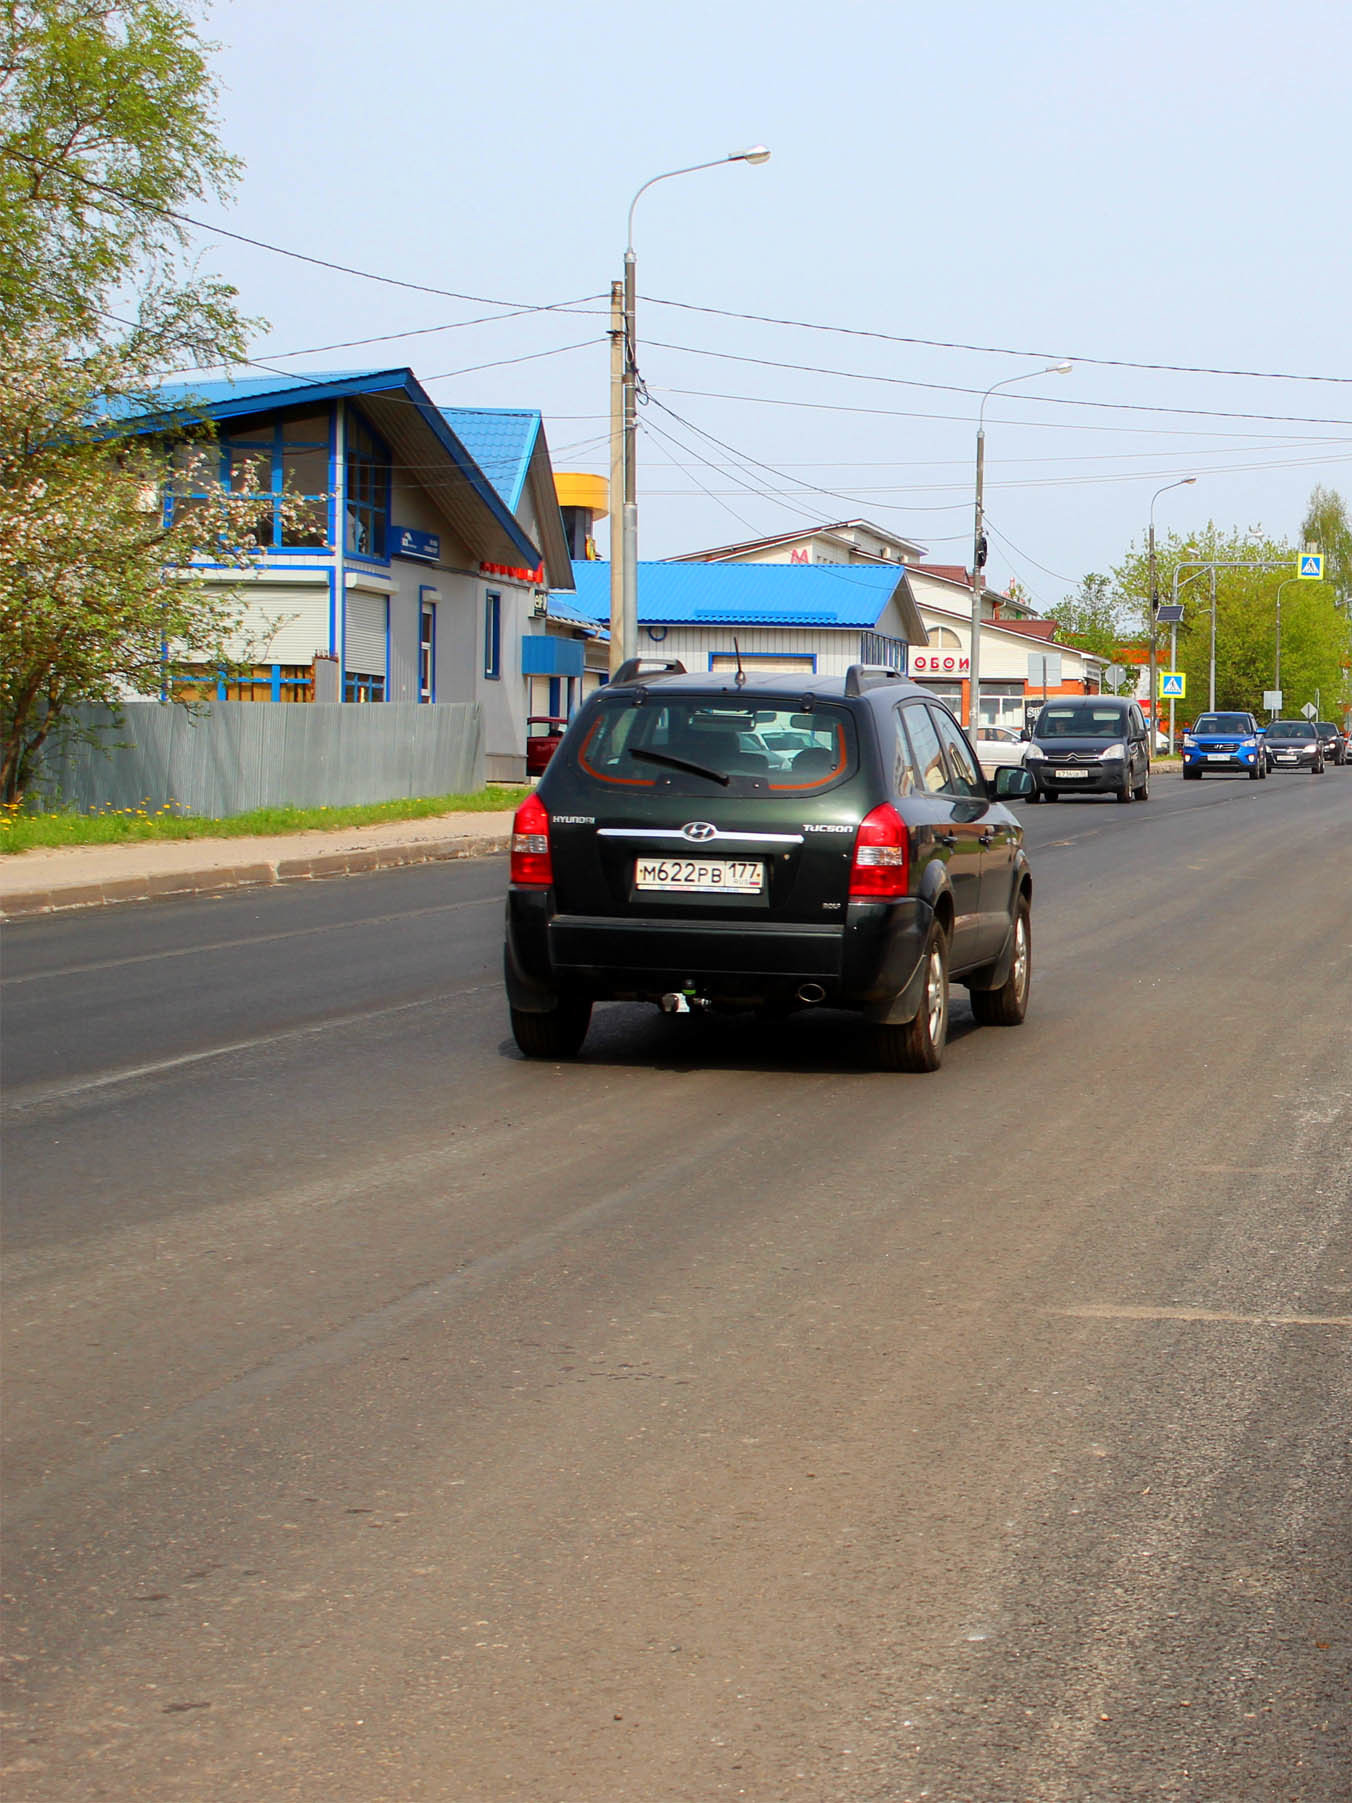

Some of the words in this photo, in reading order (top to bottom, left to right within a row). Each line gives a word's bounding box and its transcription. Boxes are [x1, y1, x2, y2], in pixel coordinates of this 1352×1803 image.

[914, 656, 970, 672] ОБОИ
[552, 815, 595, 824] HYUNDAI
[728, 863, 758, 879] 177
